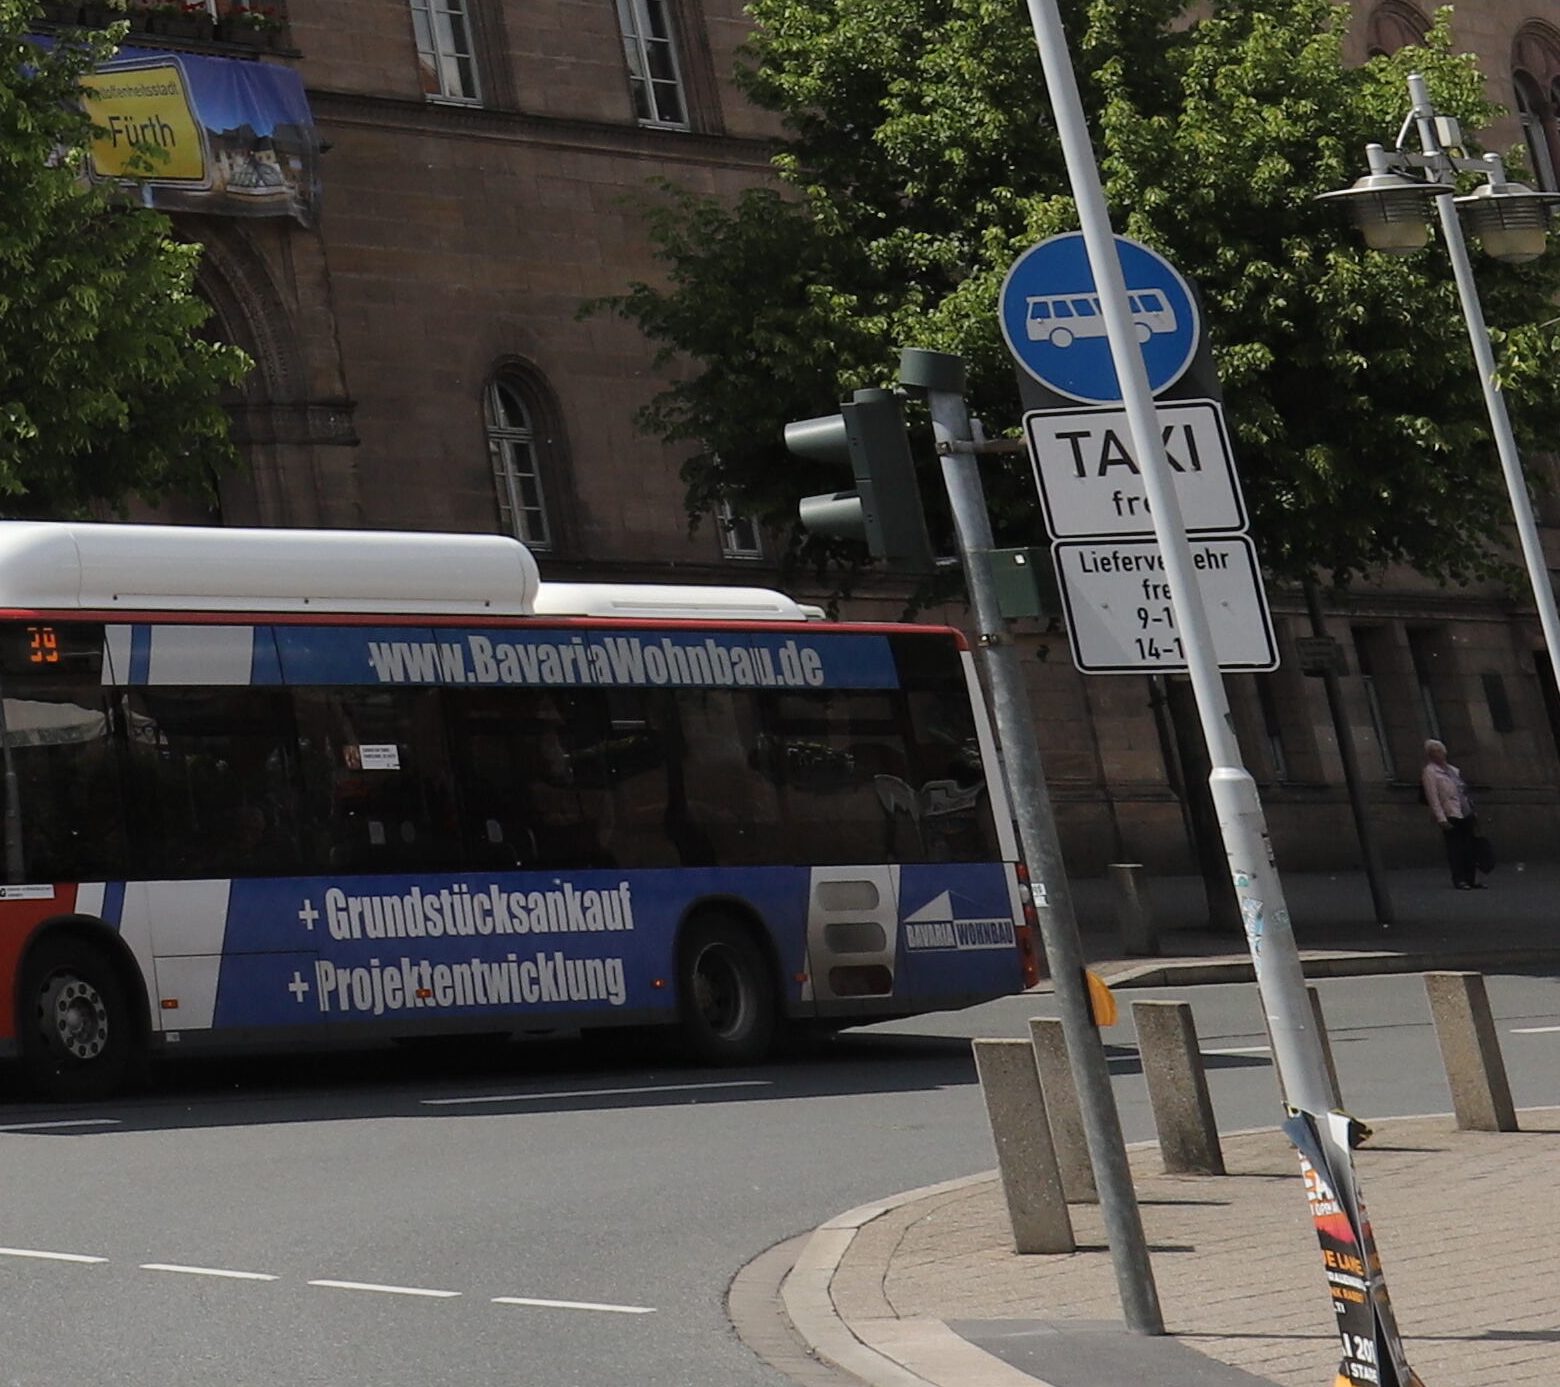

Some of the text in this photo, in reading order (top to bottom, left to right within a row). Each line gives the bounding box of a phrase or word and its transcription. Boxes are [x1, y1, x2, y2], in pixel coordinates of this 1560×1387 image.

[108, 114, 176, 148] Fürth
[1079, 547, 1229, 573] Lieferveehr
[1143, 578, 1172, 601] fre
[368, 635, 825, 687] www.BavariaWohnbau.de
[325, 880, 634, 941] Grundstücksankauf
[905, 921, 1014, 948] BAVARIA WOHNBAU
[314, 951, 627, 1015] Projektentwicklung
